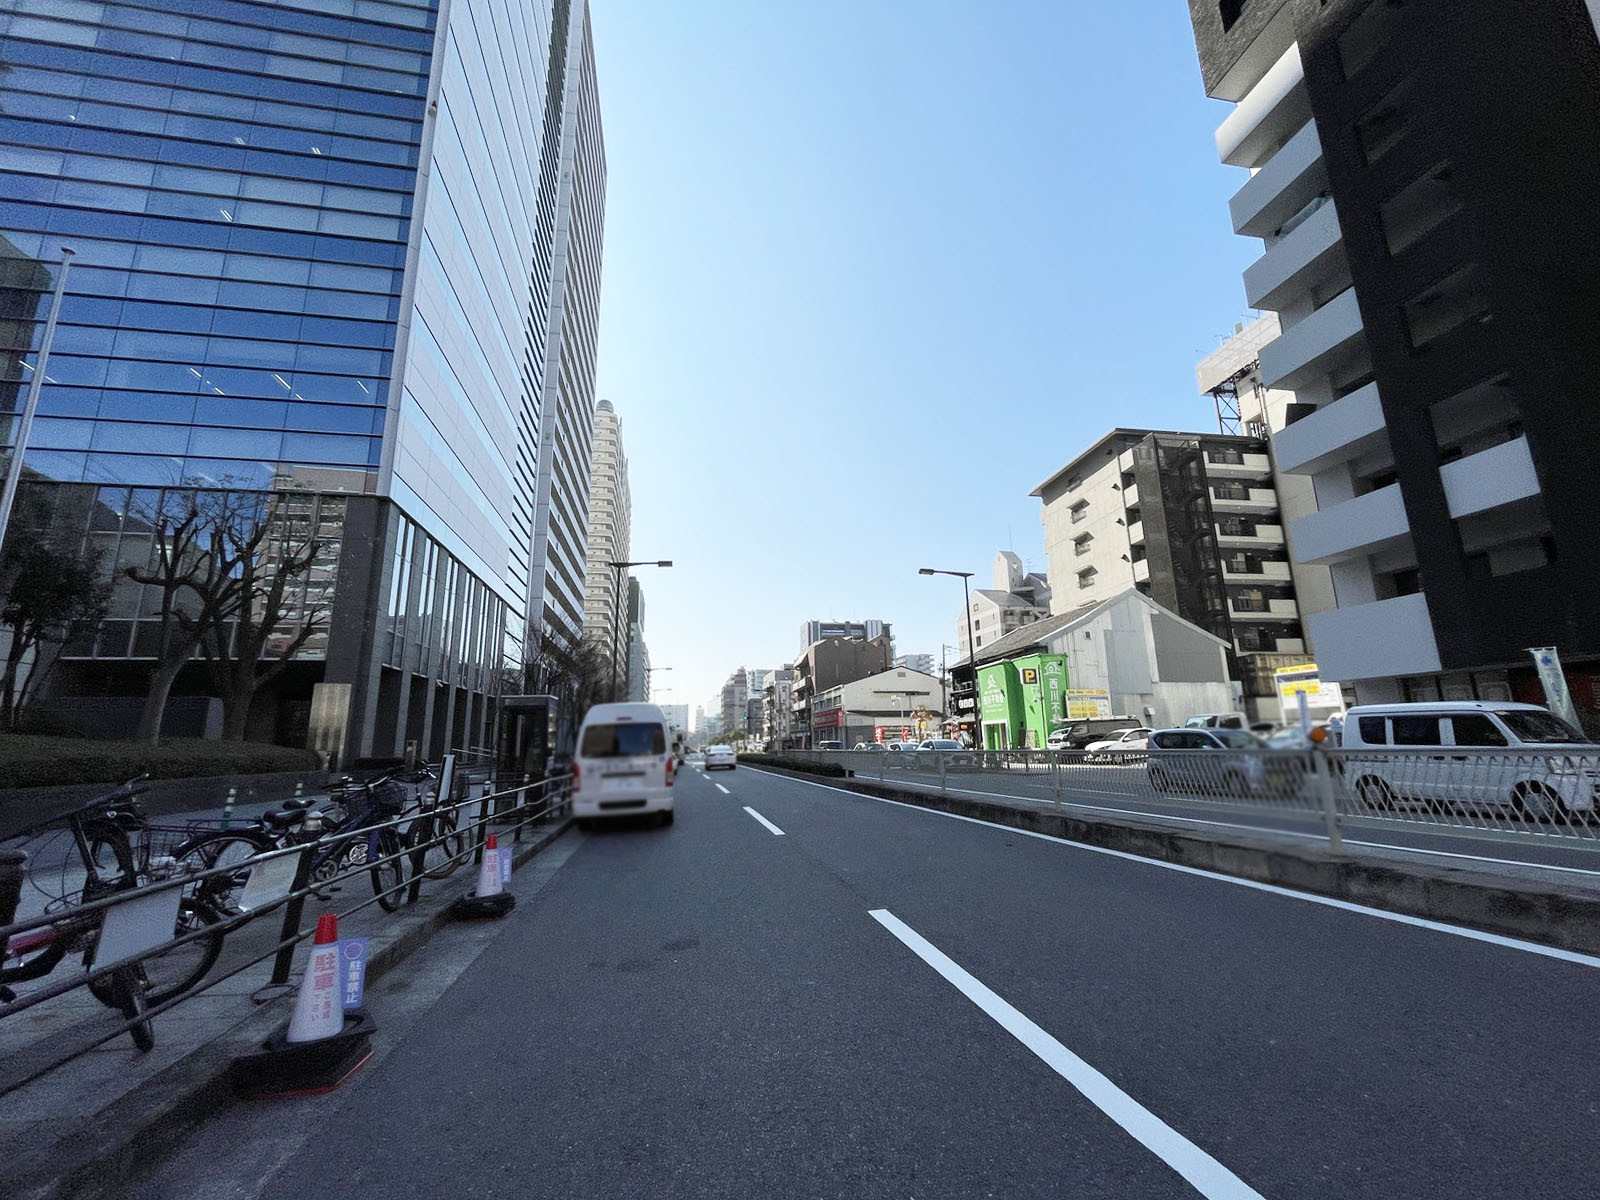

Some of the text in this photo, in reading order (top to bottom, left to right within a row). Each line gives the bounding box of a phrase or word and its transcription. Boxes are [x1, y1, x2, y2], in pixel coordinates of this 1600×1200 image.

[1025, 670, 1035, 683] P
[313, 952, 336, 992] 駐車
[345, 960, 362, 1004] 駐車禁止
